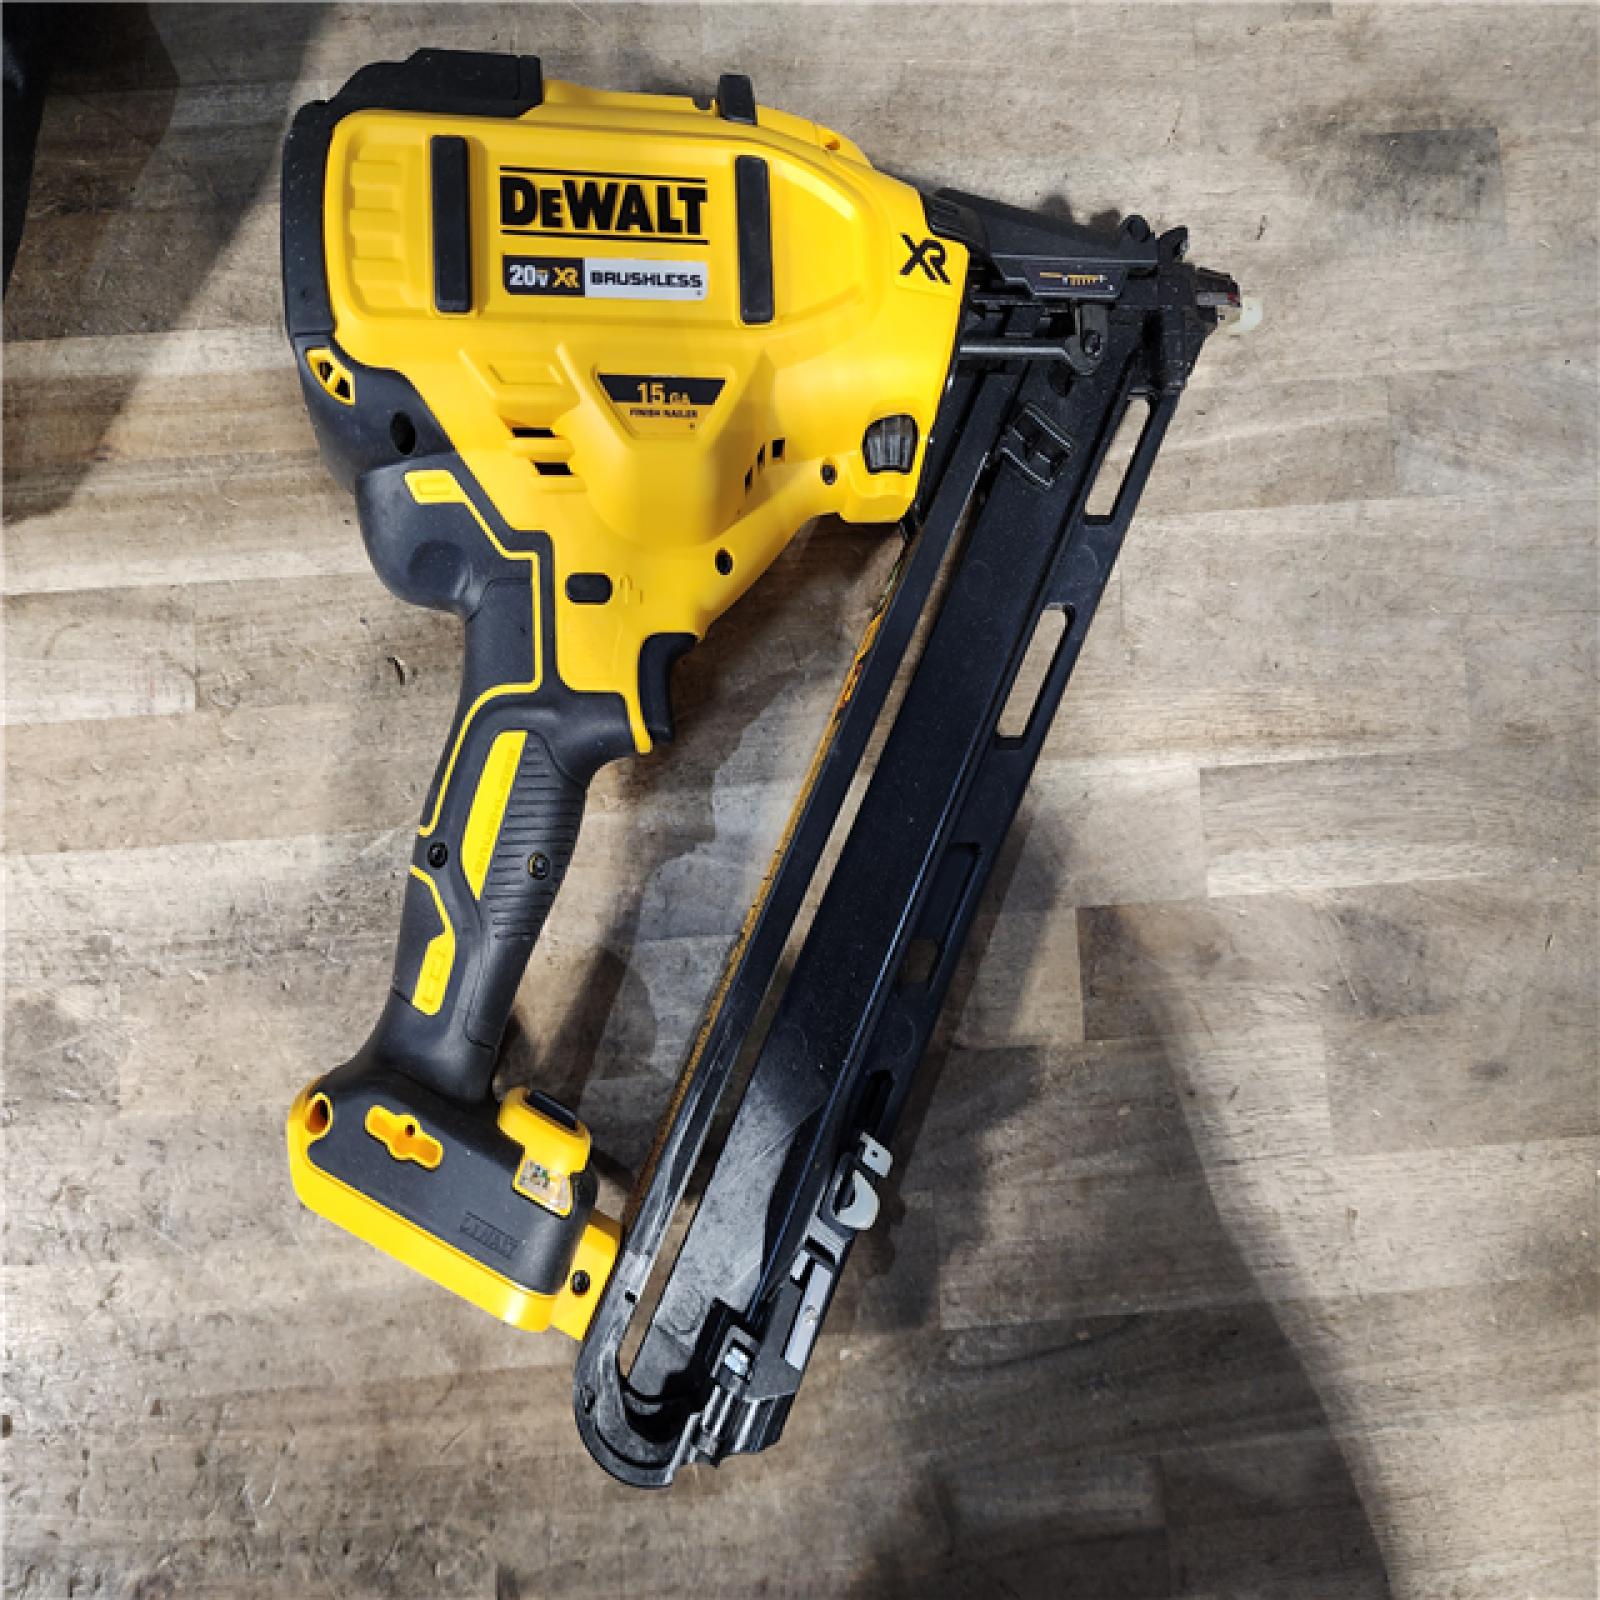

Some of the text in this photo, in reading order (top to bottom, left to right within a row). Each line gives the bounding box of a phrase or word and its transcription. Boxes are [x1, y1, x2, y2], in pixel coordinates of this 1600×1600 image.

[552, 266, 580, 289] XR
[590, 271, 702, 288] BRUSHLESS
[900, 233, 951, 285] XR
